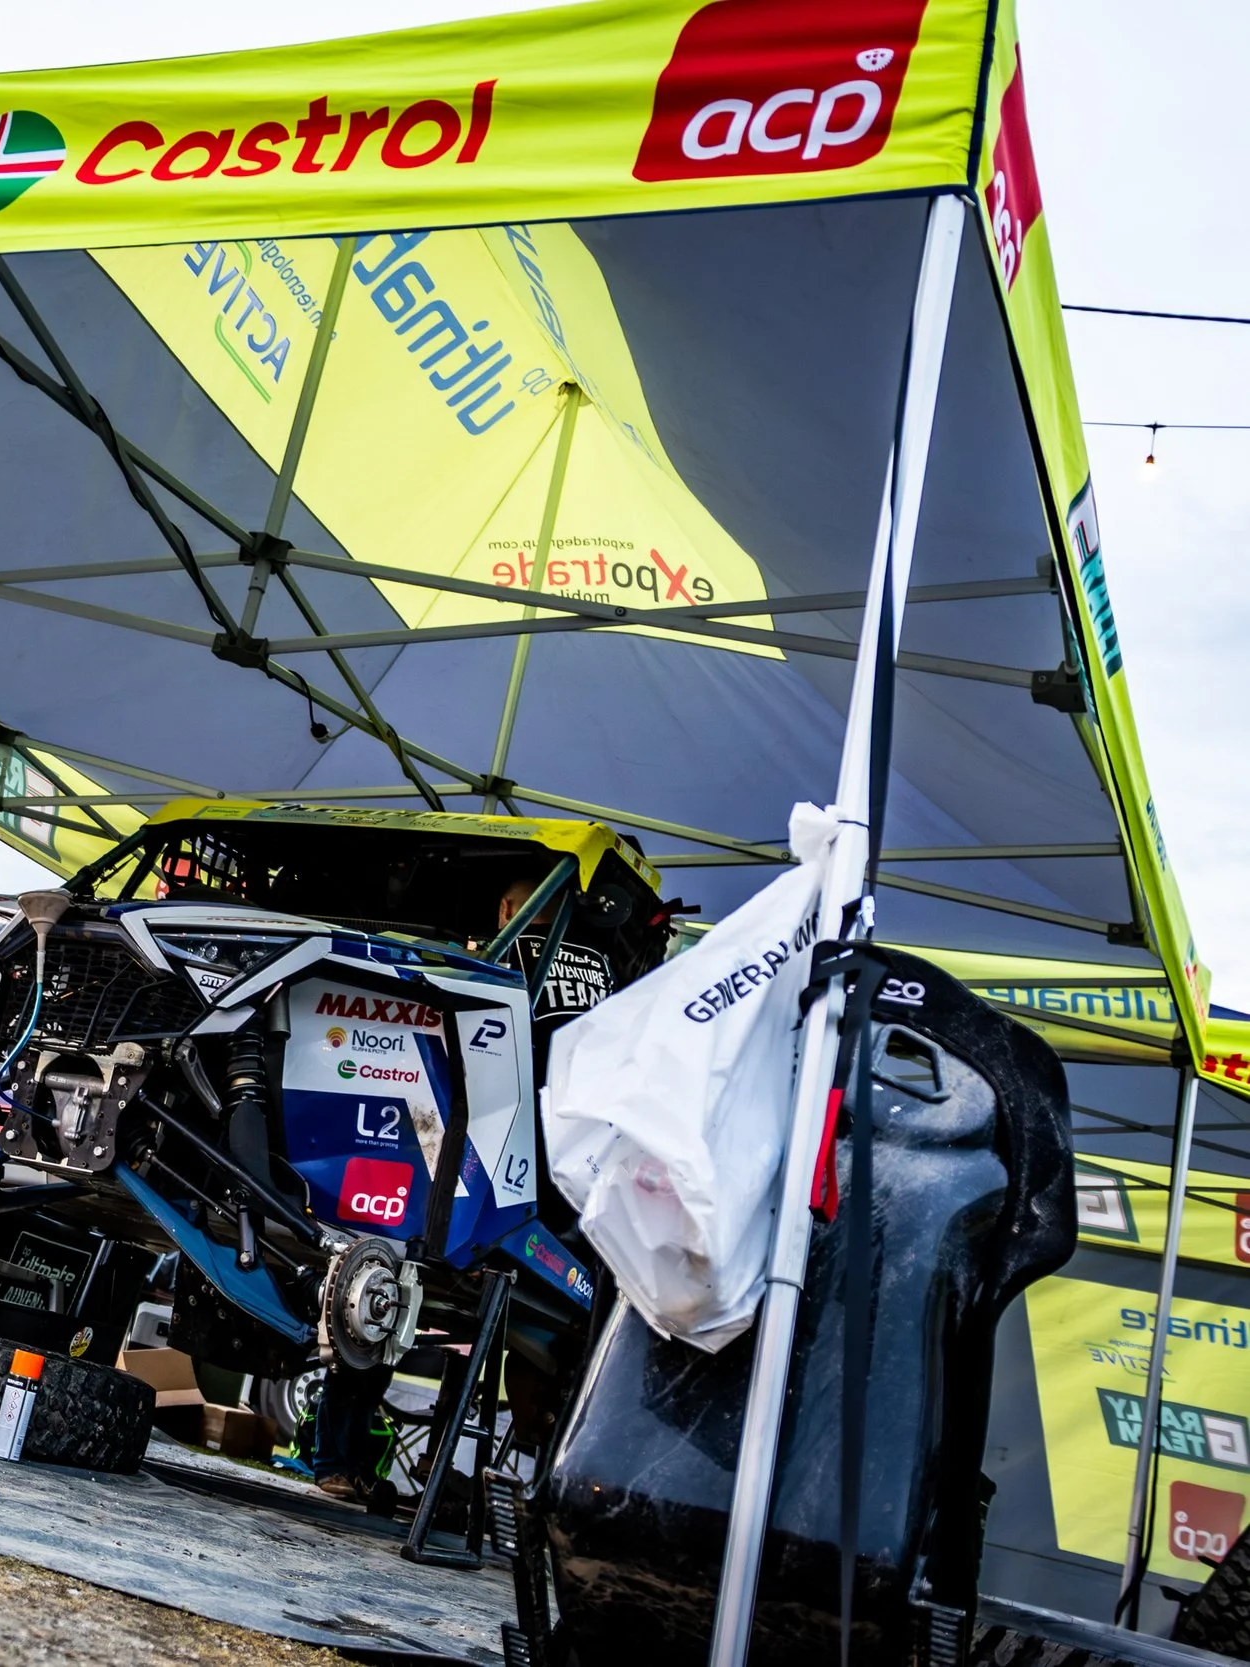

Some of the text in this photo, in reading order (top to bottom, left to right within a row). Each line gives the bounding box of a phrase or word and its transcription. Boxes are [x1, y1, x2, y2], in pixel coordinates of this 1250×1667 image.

[75, 80, 497, 185] Castrol
[681, 80, 881, 162] acp
[316, 992, 443, 1028] MAXXIS
[359, 1064, 419, 1083] Castrol
[356, 1102, 401, 1140] L2
[351, 1192, 405, 1220] acp
